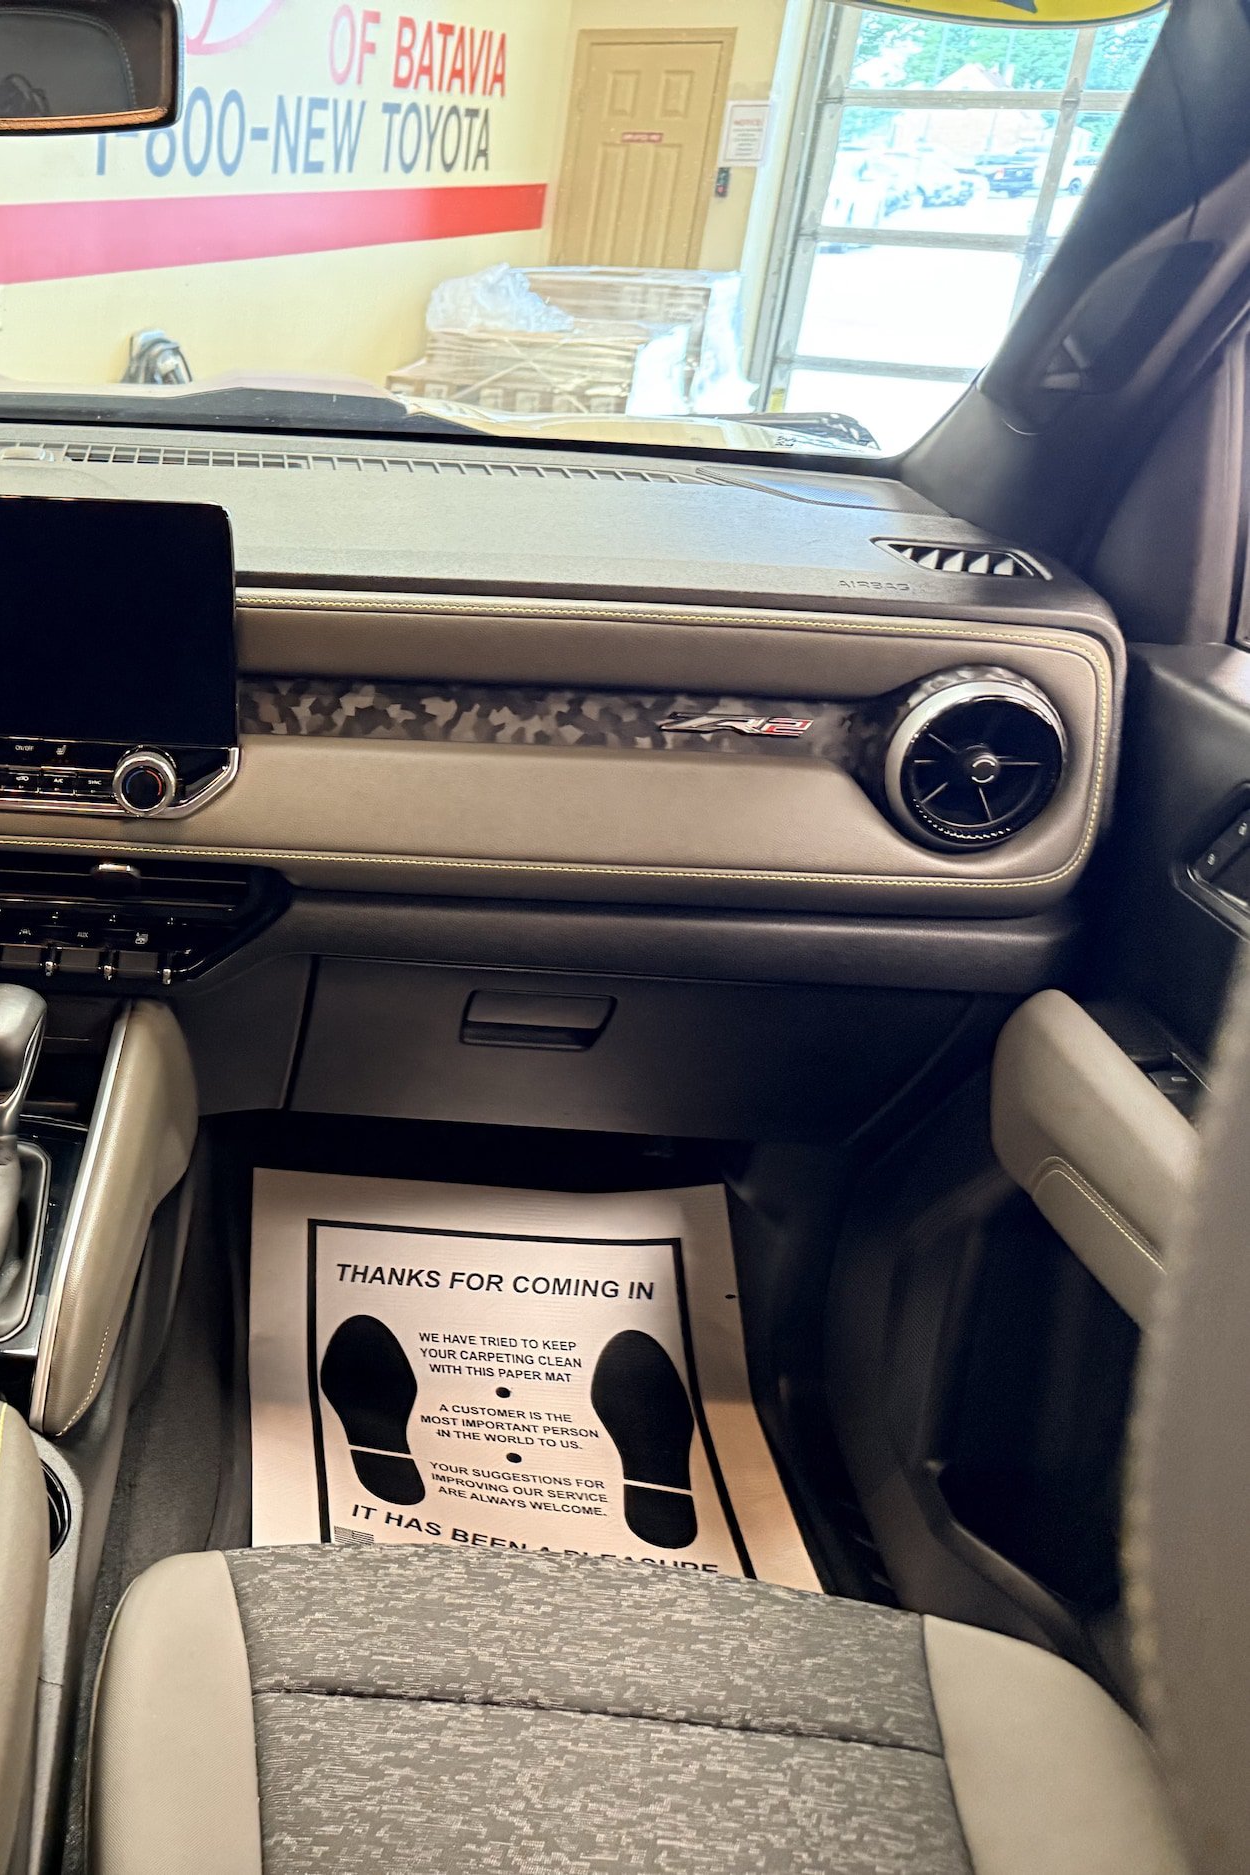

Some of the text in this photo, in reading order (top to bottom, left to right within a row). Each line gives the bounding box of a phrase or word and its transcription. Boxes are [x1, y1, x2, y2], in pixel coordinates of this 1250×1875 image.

[328, 4, 507, 98] OF BATAVIA
[381, 101, 491, 174] TOYOTA
[838, 580, 910, 591] AIRBAG
[659, 711, 814, 738] ZR2
[337, 1263, 655, 1300] THANKS FOR COMING IN
[419, 1332, 577, 1352] WE HAVE TRIED TO KEEP
[420, 1347, 582, 1368] YOUR CARPETING CLEAN
[429, 1363, 571, 1383] WITH THIS PAPER MAT
[420, 1414, 600, 1439] MOST IMPORTANT PERSON
[439, 1403, 572, 1423] A CUSTOMER IS THE
[436, 1428, 583, 1450] IN THE WORLD TO US.
[430, 1461, 605, 1490] YOUR SUGGESTIONS FOR
[431, 1473, 608, 1503] IMPROVING OUR SERVICE
[438, 1486, 608, 1517] ARE ALWAYS WELCOME.
[351, 1504, 528, 1550] IT HAS BEEN
